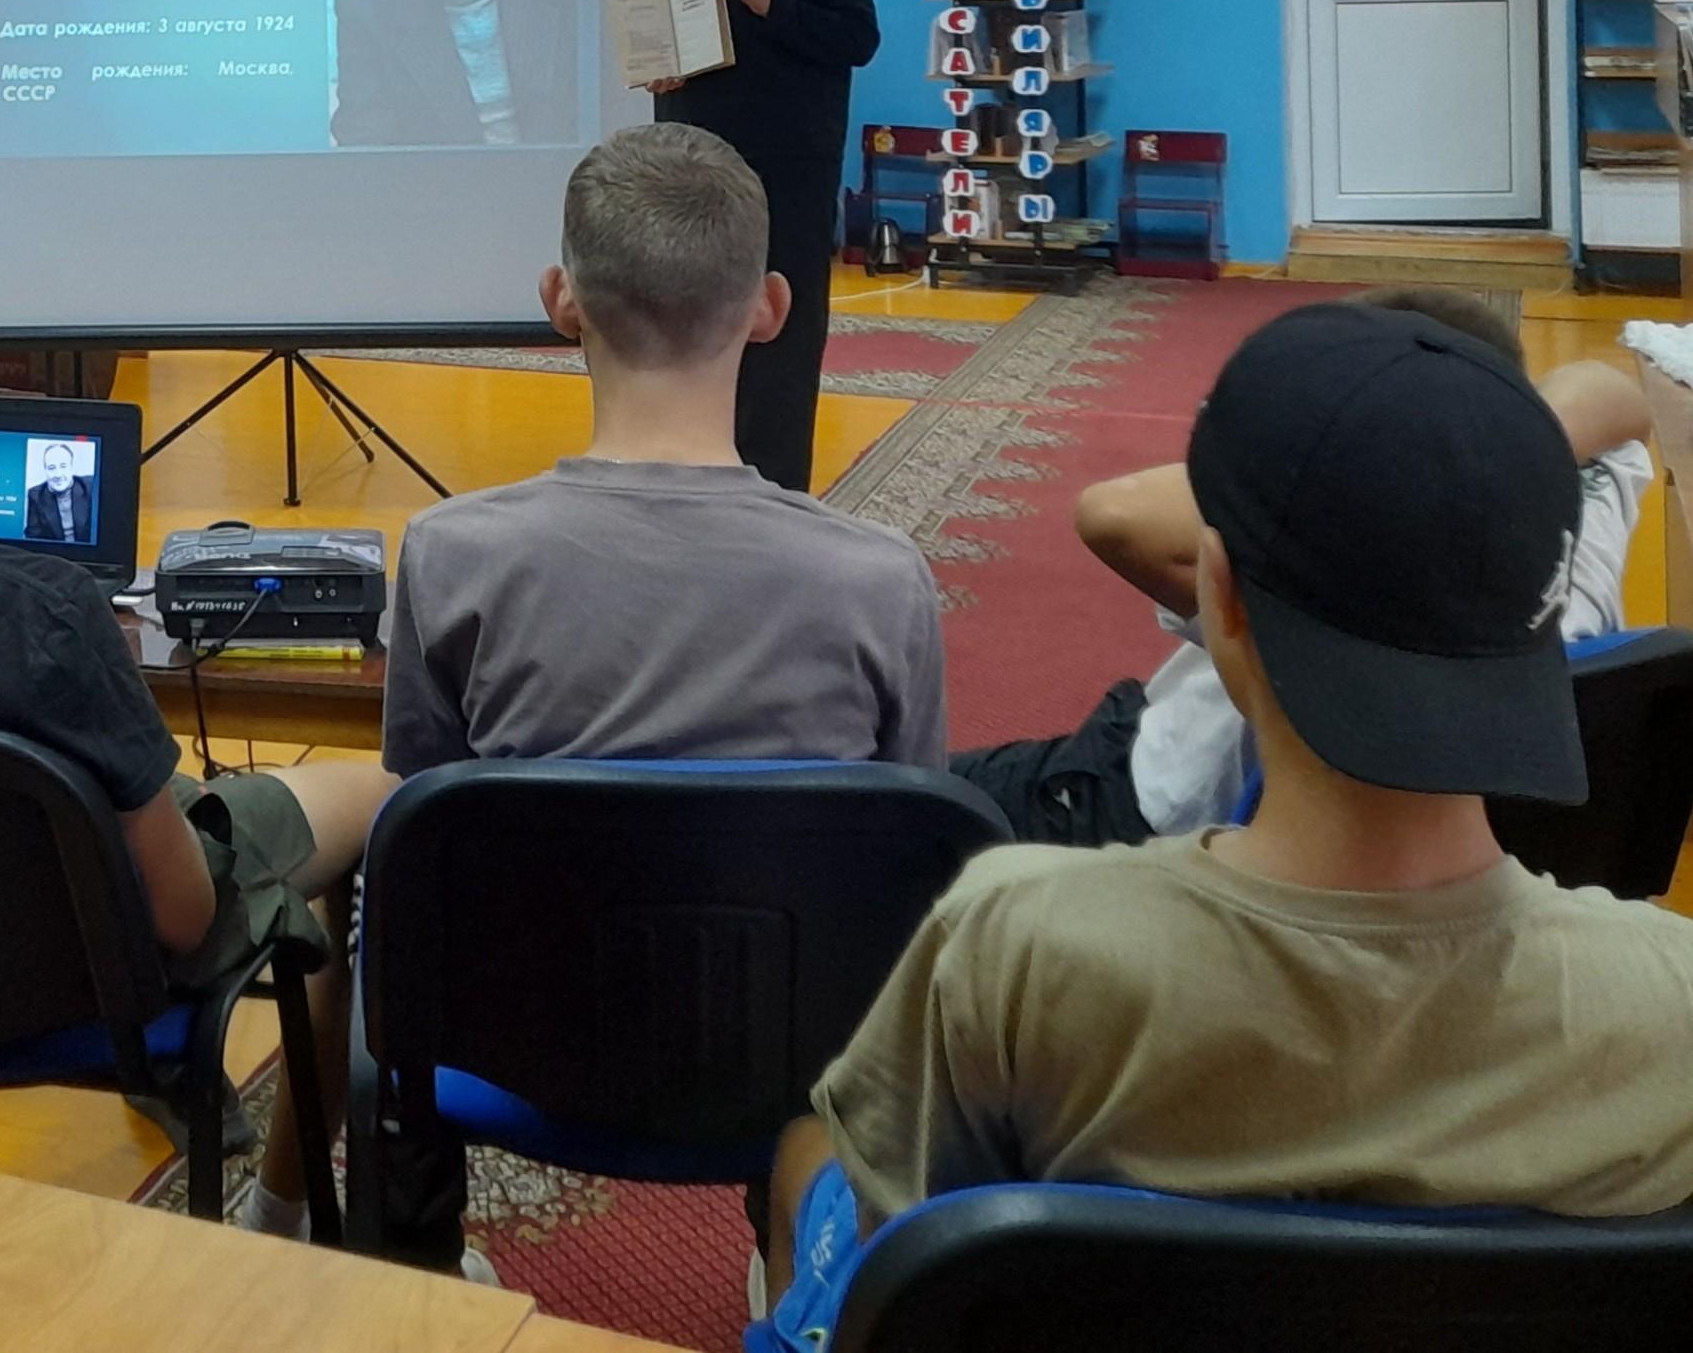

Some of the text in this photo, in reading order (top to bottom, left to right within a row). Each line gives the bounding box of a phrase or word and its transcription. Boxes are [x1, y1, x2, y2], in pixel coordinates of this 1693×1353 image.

[0, 16, 295, 38] Дата рождения: 3 августа 1924
[1, 65, 63, 80] Место
[91, 63, 189, 81] рождения:
[3, 84, 56, 101] СССР
